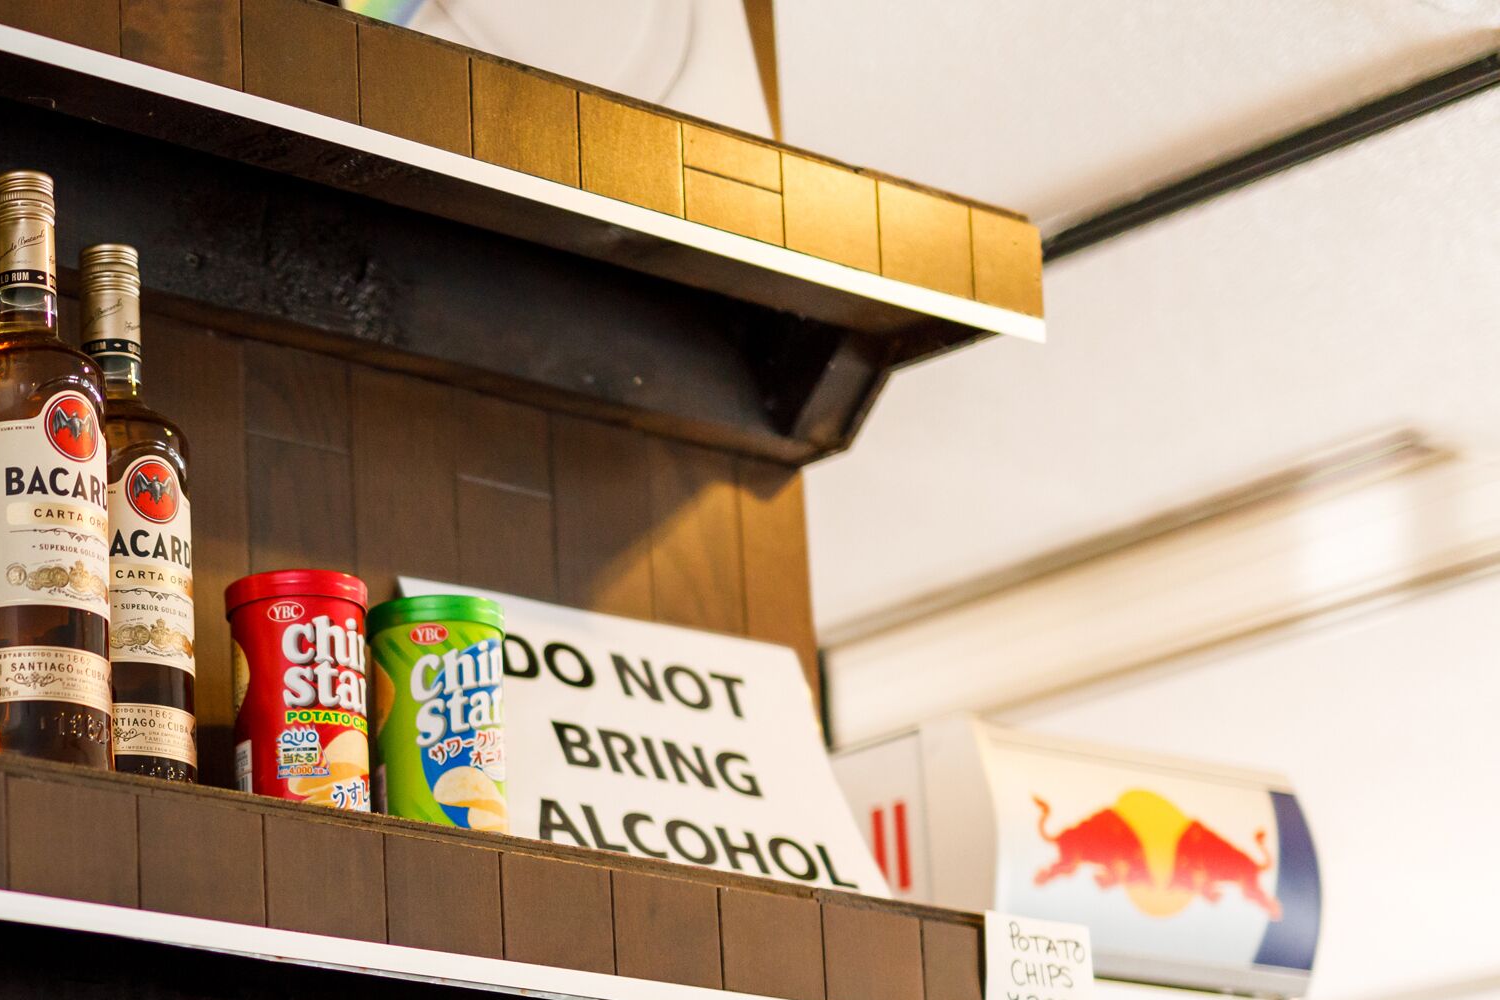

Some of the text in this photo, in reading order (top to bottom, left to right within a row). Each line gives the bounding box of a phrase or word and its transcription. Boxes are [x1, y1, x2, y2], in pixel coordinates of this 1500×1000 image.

[11, 272, 29, 282] RUM
[5, 466, 108, 511] BACARD
[34, 508, 83, 522] CARTA
[39, 543, 78, 555] SUPERIOR
[109, 528, 190, 569] ACARD
[115, 569, 165, 582] CARTA
[121, 602, 159, 612] SUPERIOR
[161, 606, 177, 617] GOLD
[273, 605, 299, 621] YBC
[415, 626, 443, 642] YBC
[11, 661, 74, 674] SANTIAGO
[85, 667, 106, 682] CUBA
[502, 632, 746, 720] DO NOT
[112, 717, 156, 728] NTIAGO
[167, 721, 189, 735] CUBA
[286, 711, 350, 726] POTATO
[282, 730, 317, 746] QUO
[282, 752, 318, 764] 当たる!
[550, 720, 764, 798] BRING
[538, 797, 861, 891] ALCOHOL
[1009, 921, 1086, 965] POTATO
[1010, 958, 1075, 990] CHIPS
